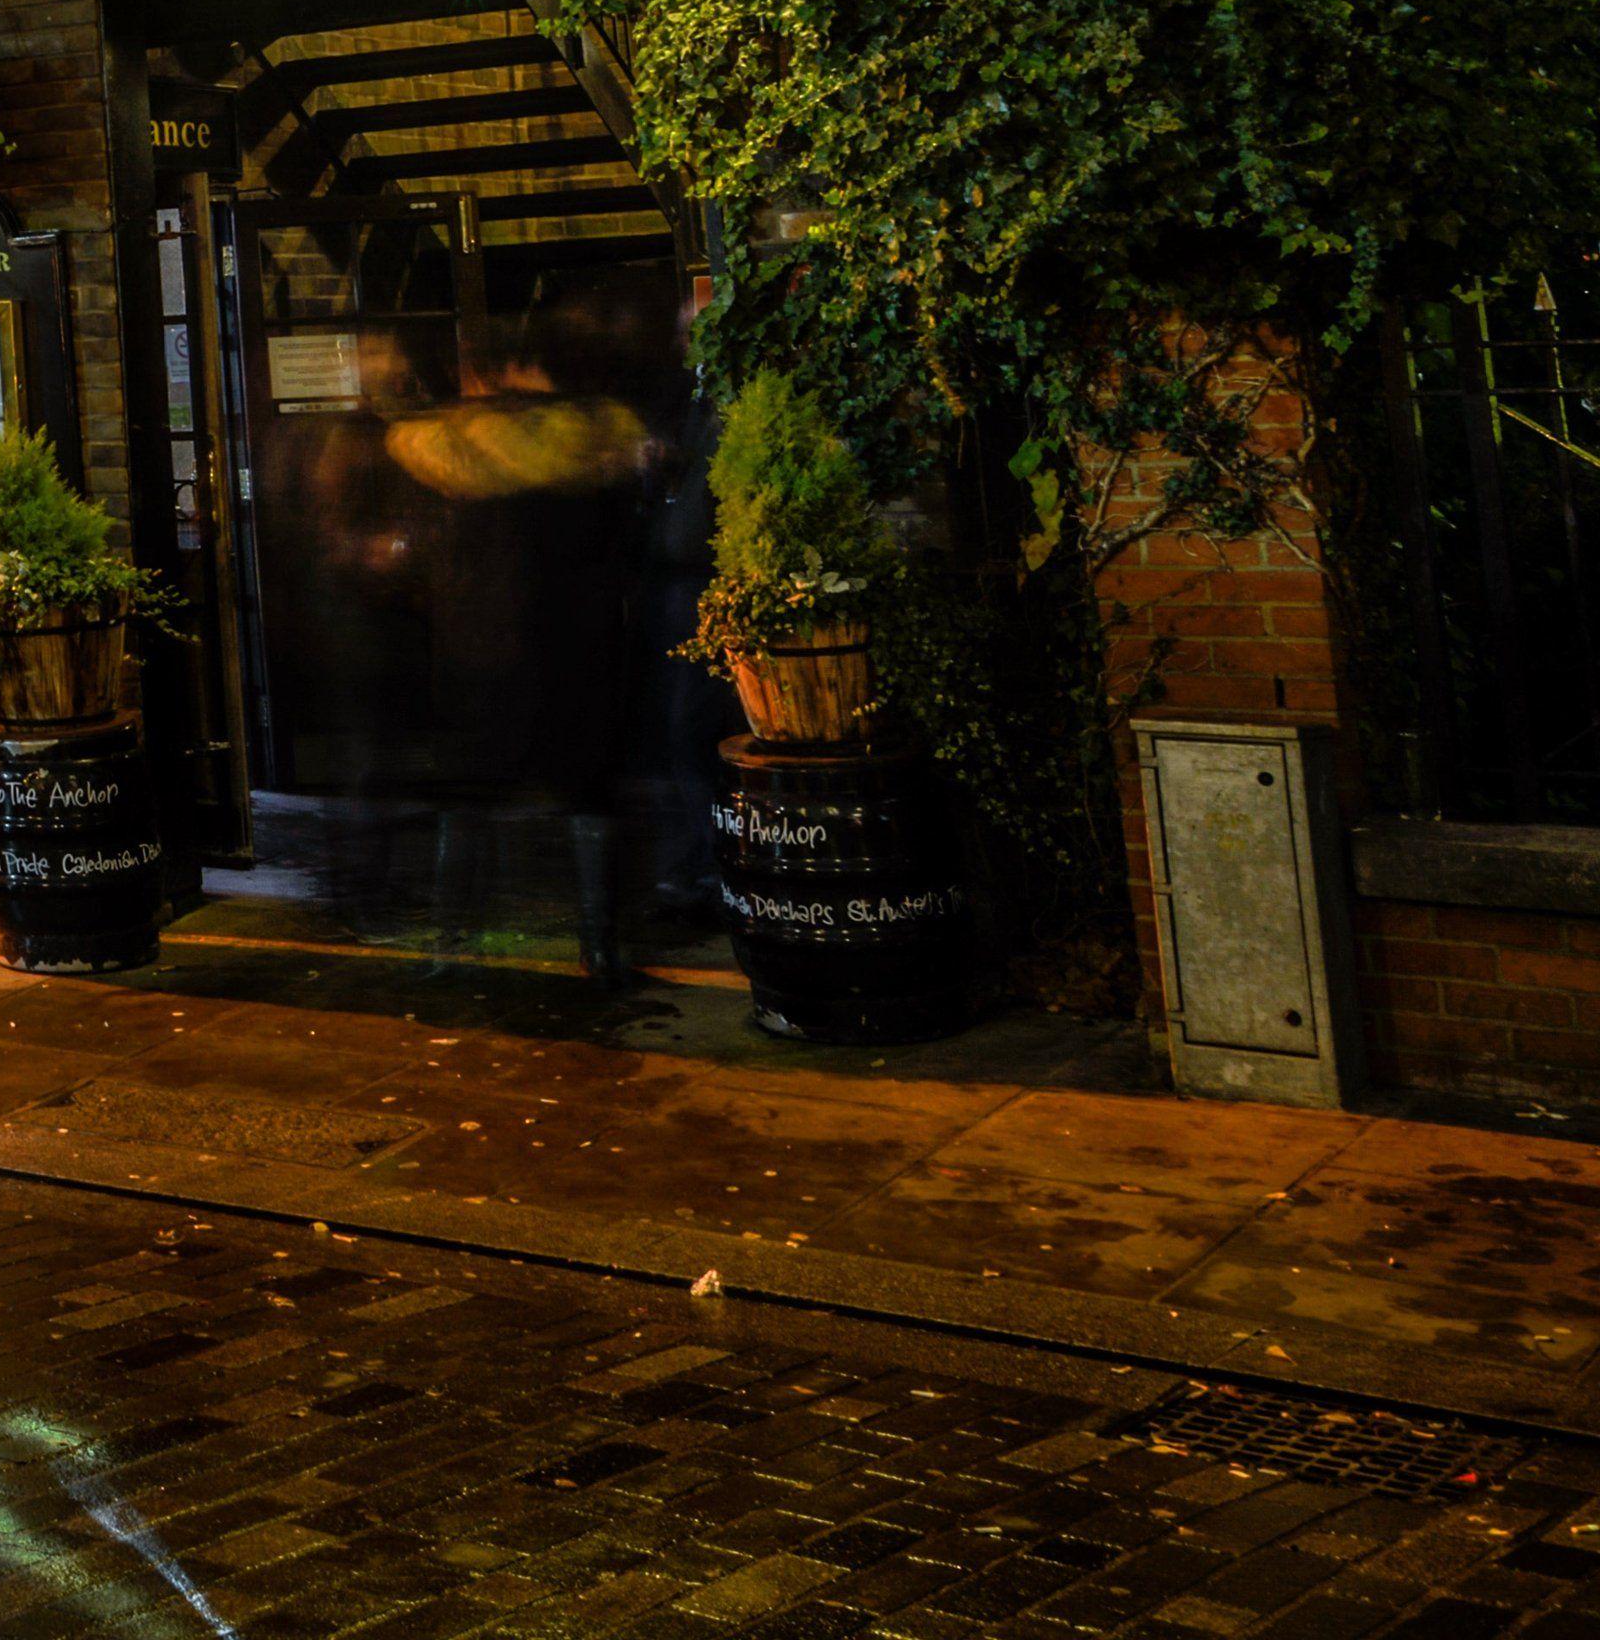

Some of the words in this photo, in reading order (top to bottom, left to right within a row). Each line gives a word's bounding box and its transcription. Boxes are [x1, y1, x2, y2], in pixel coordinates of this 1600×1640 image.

[5, 780, 37, 808] The
[49, 780, 119, 808] Anchor
[749, 805, 827, 849] Anchor
[1, 850, 50, 879] Pride
